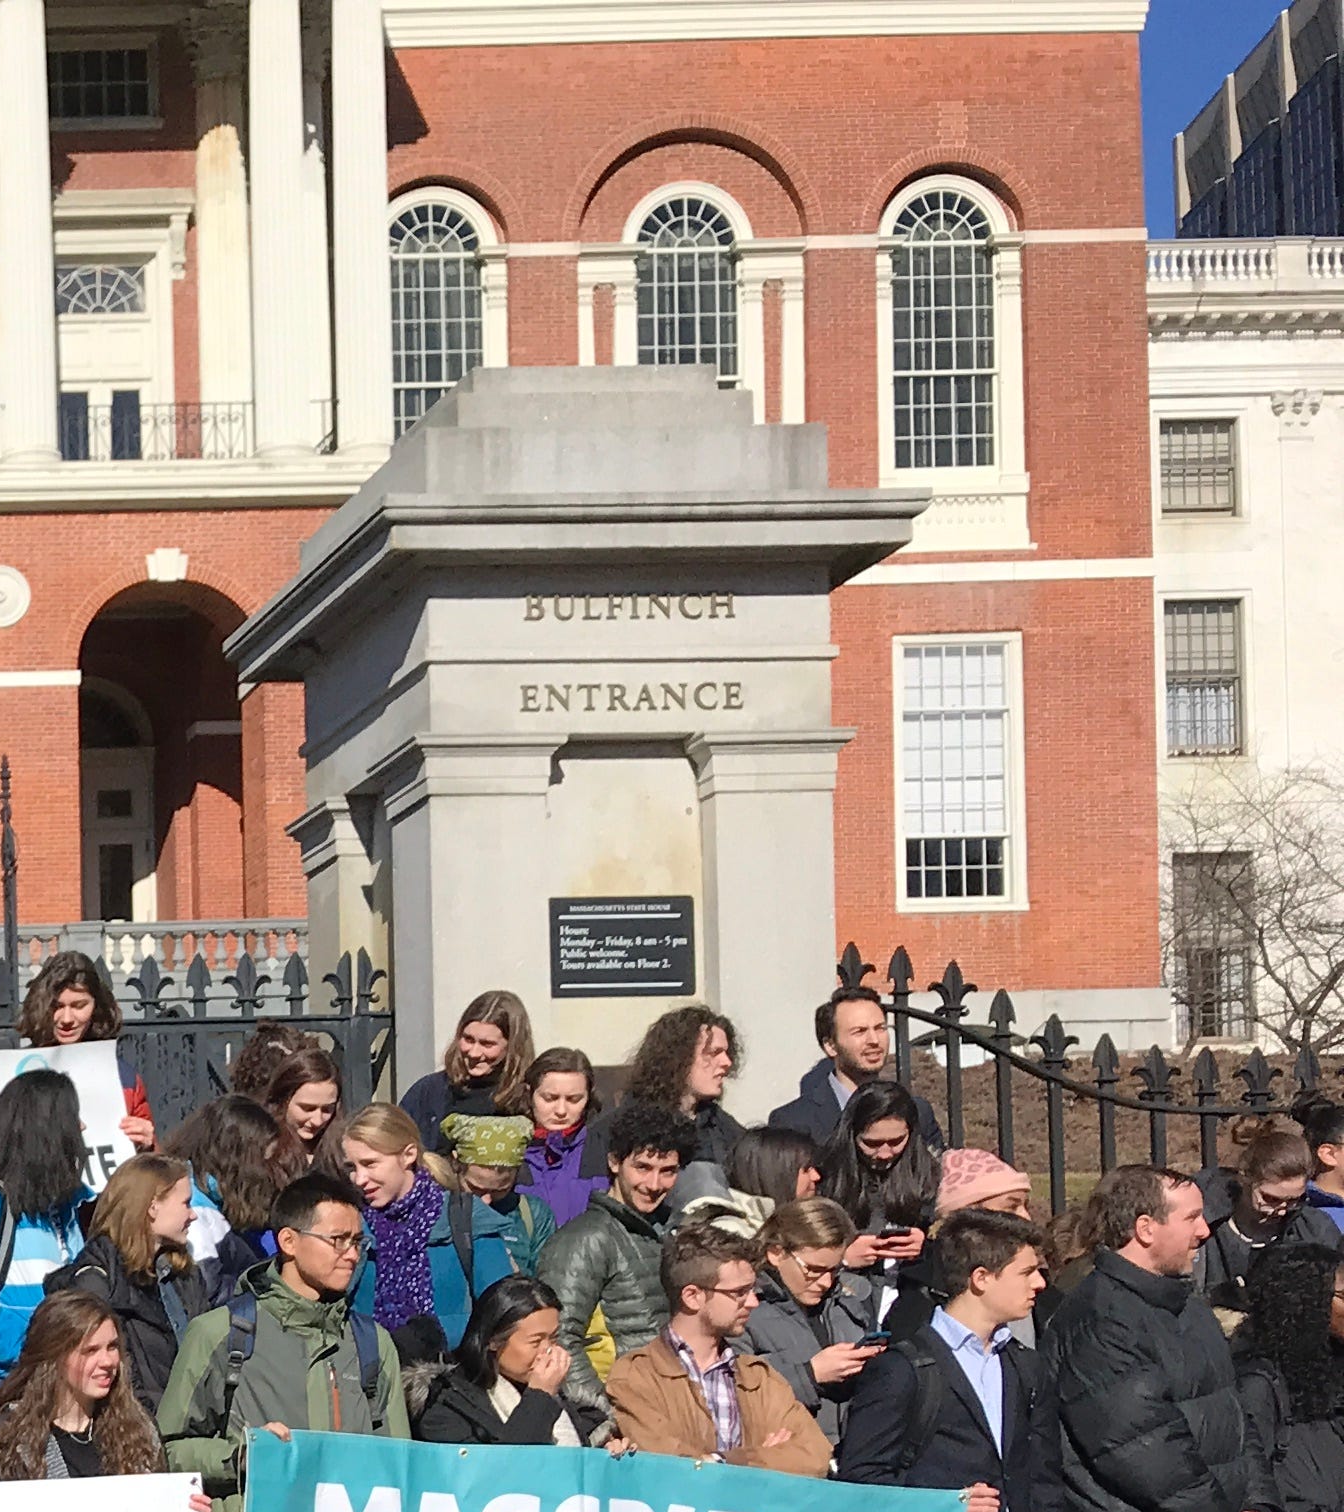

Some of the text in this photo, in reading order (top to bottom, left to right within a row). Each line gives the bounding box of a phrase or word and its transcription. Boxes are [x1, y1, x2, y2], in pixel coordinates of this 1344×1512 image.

[522, 593, 737, 622] BULFINCH
[519, 681, 745, 713] ENTRANCE
[559, 925, 590, 936] Hours:
[559, 936, 597, 949] Monday
[605, 935, 633, 948] Friday,
[635, 935, 642, 946] 8
[643, 937, 657, 946] am
[664, 935, 671, 946] 5
[672, 937, 688, 948] pm
[560, 948, 628, 959] Public welcome.
[560, 959, 586, 970] Tours
[586, 959, 623, 970] available
[623, 961, 636, 969] on
[637, 958, 661, 969] Floor
